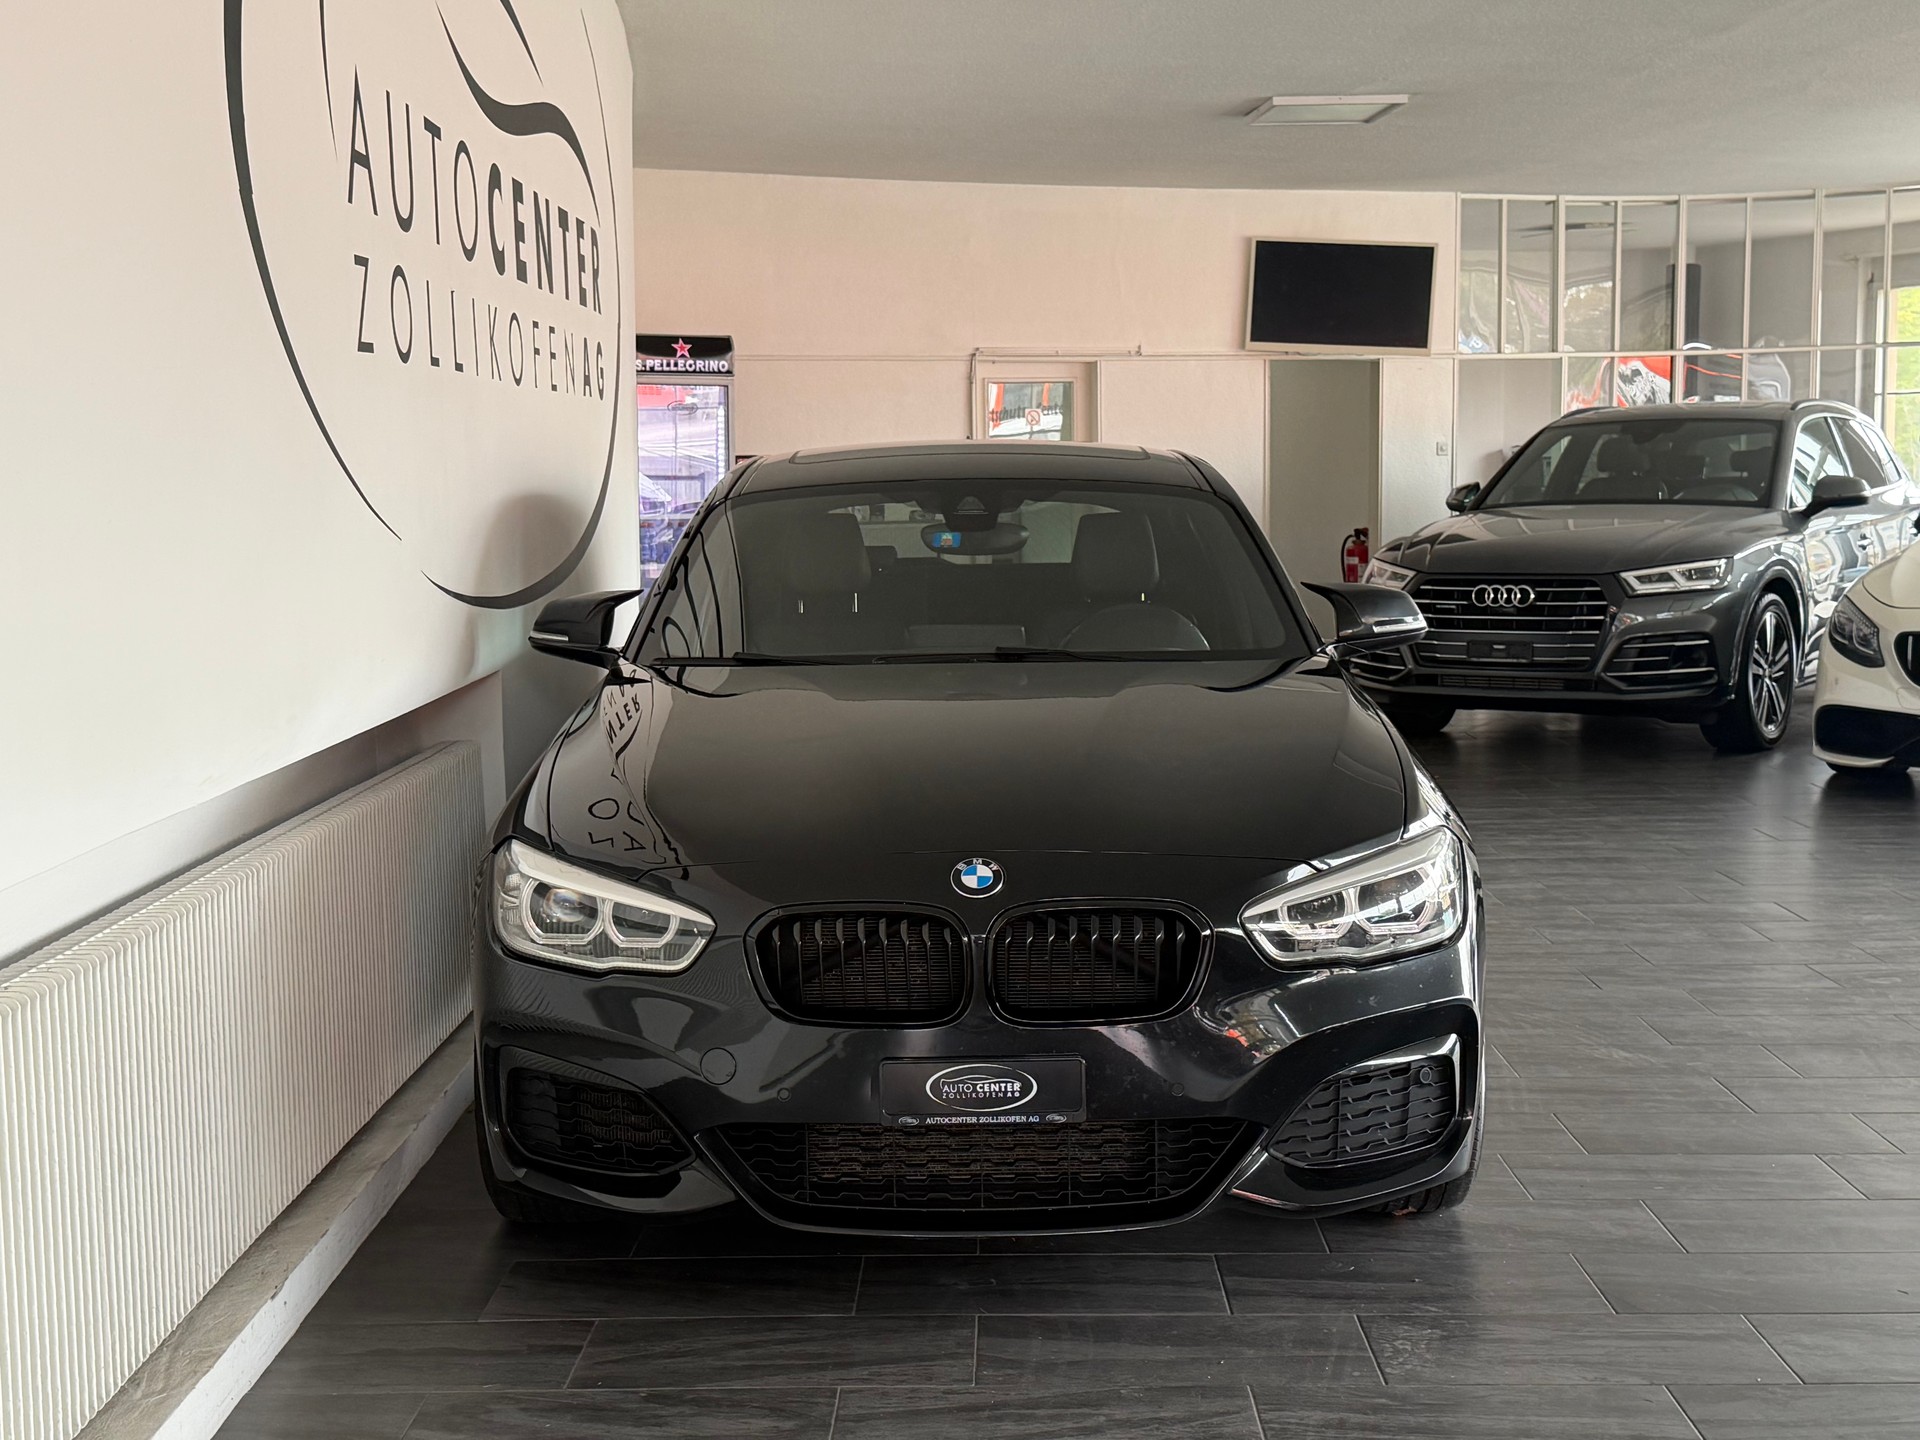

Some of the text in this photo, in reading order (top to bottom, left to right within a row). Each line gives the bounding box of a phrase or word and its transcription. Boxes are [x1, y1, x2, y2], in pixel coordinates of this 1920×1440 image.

[635, 359, 729, 372] S.PELLEGRINO
[956, 858, 1000, 871] BMW
[942, 1082, 1021, 1093] AUTO CENTER
[925, 1116, 978, 1125] AUTOCENTER
[979, 1115, 1028, 1124] ZOLLIKOFEN
[1028, 1115, 1040, 1123] AG
